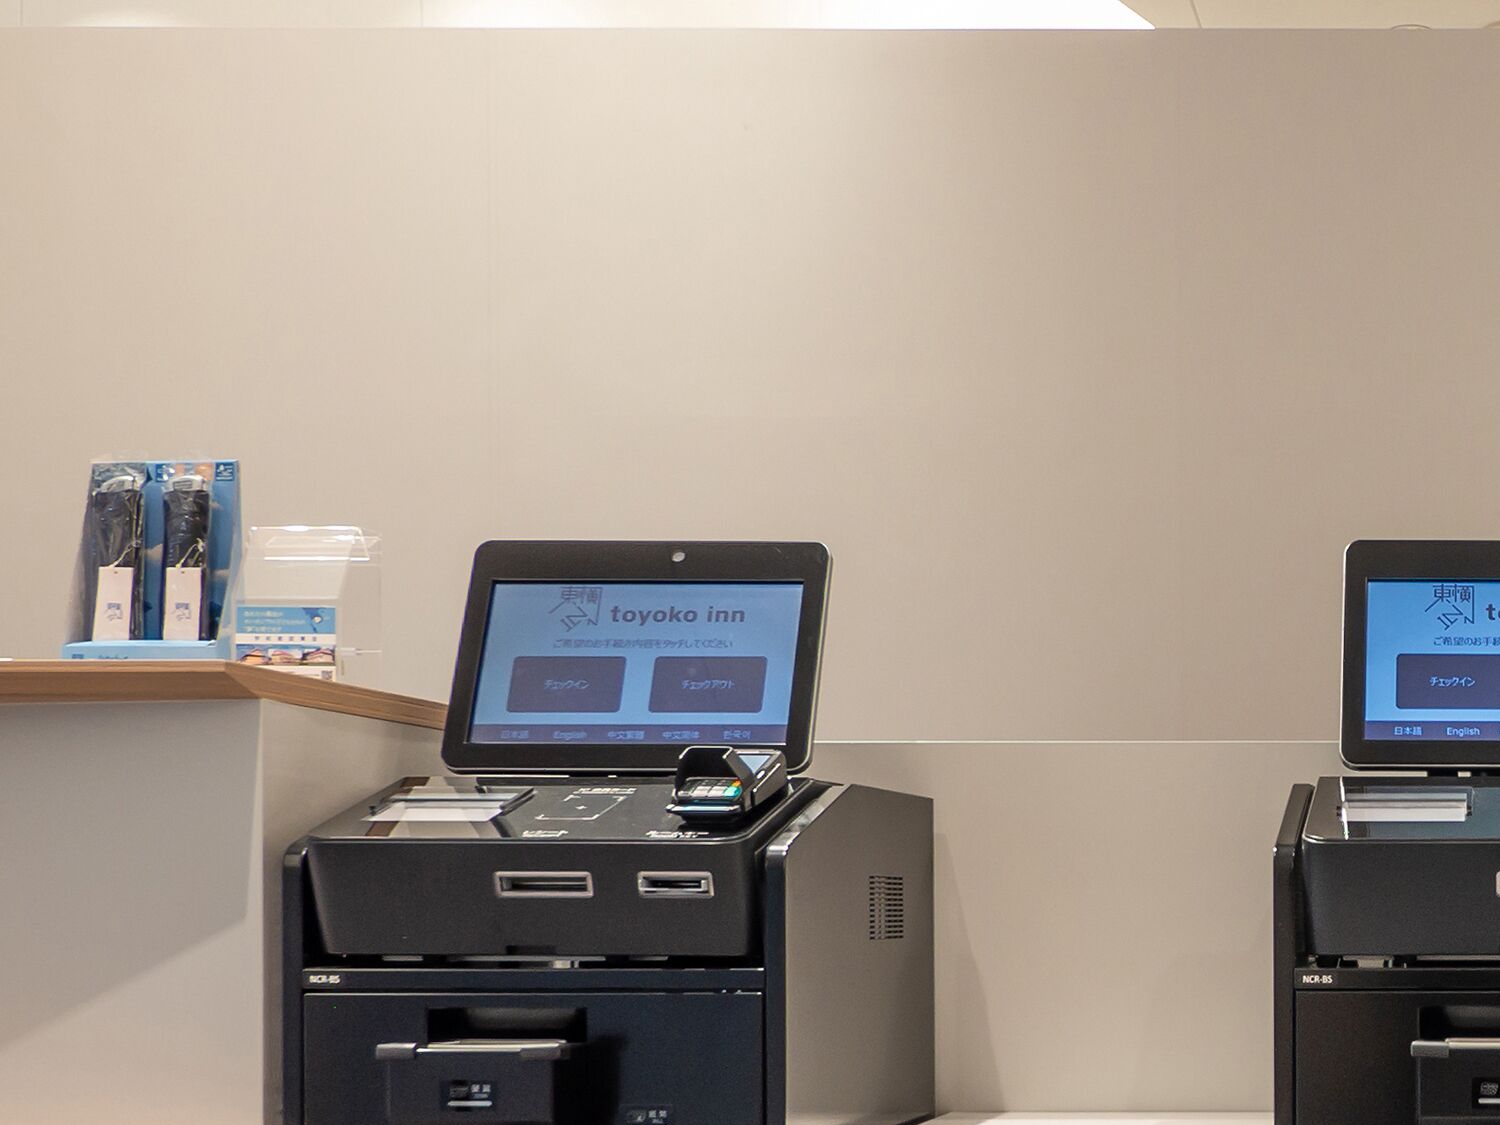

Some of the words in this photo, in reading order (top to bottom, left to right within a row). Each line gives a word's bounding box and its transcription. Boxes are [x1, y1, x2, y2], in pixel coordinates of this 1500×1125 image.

[611, 606, 698, 627] toyoko
[707, 606, 745, 623] inn
[1430, 677, 1476, 687] チェックイン
[1394, 727, 1422, 736] 日本語
[1447, 727, 1480, 737] English
[1302, 975, 1333, 984] NCR-BS
